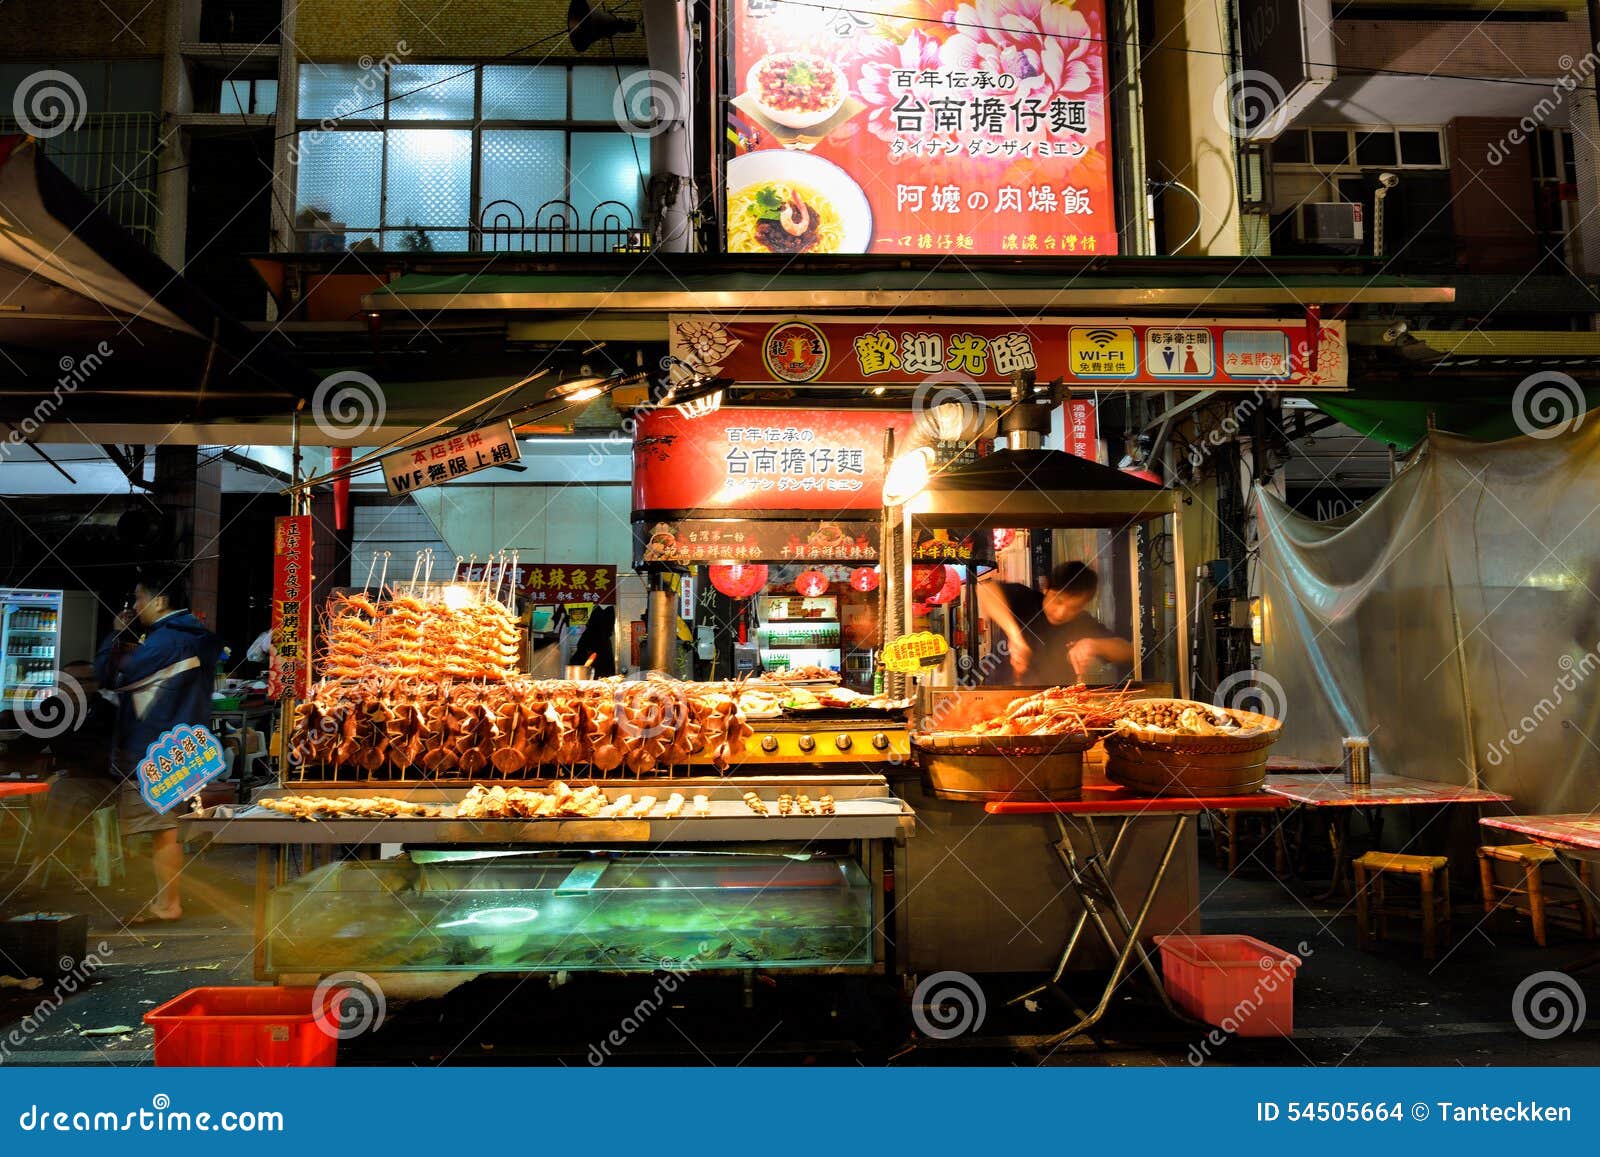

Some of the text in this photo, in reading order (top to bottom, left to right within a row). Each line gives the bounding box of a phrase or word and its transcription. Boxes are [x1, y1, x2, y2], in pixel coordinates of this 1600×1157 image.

[892, 70, 1015, 89] 百年伝承の
[893, 95, 1088, 134] 台南擔仔麵
[892, 138, 1086, 156] タイナン ダンザイミエン
[897, 183, 1093, 215] 阿嬤の肉燥飯
[1002, 233, 1097, 250] 濃濃台灣情
[1151, 332, 1209, 345] 乾淨衛生間
[854, 329, 1038, 377] 歡迎光臨
[1079, 350, 1125, 361] WI-FI
[1225, 352, 1283, 367] 冷氣開放
[1079, 362, 1127, 373] 免費提供
[726, 428, 813, 442] 百年伝承の
[411, 432, 483, 465] 本店提供
[726, 447, 864, 474] 台南擔仔麵
[778, 478, 864, 491] ダンザイミエン
[527, 567, 611, 591] 麻辣魚蛋
